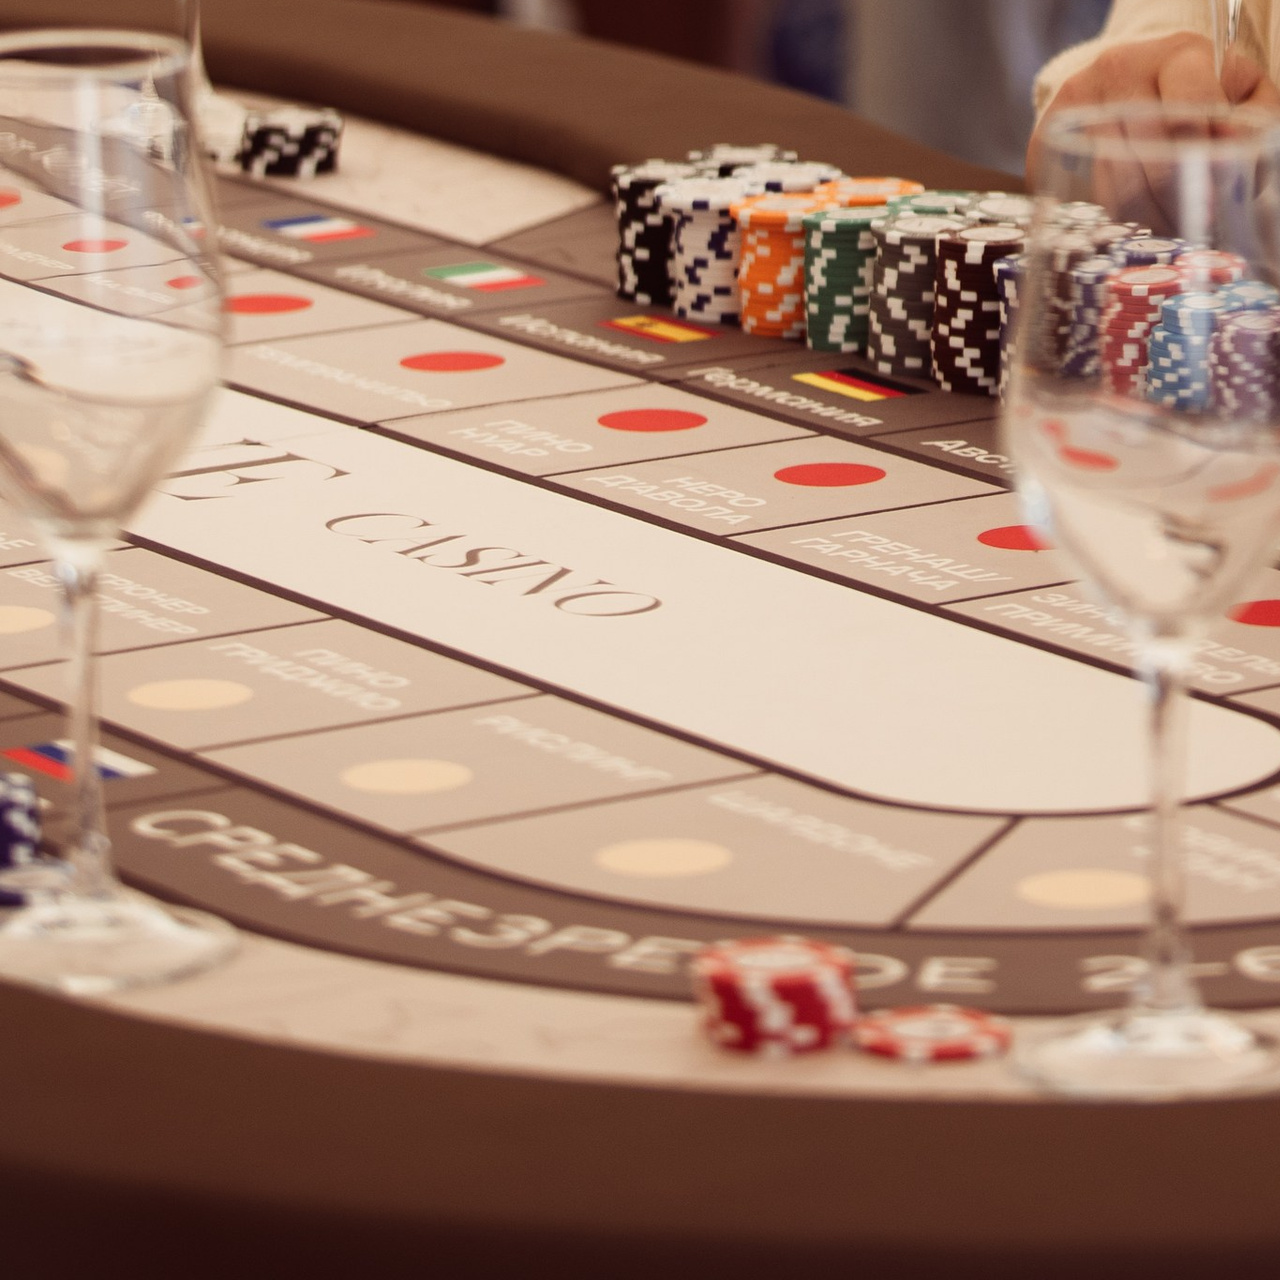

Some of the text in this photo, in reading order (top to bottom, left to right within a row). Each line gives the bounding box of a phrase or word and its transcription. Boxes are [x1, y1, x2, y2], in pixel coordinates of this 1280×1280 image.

[686, 365, 884, 429] Германия
[449, 426, 549, 458] НУАР
[484, 419, 594, 454] ПИНО
[584, 474, 753, 526] Д'АВОЛА
[662, 475, 768, 509] НЕРО
[325, 512, 663, 617] CASINO
[789, 536, 960, 592] ГАРНАЧА
[830, 529, 1014, 583] ГРЕНАШ/
[129, 807, 999, 996] СРЕДНЕЗРЕОЕ
